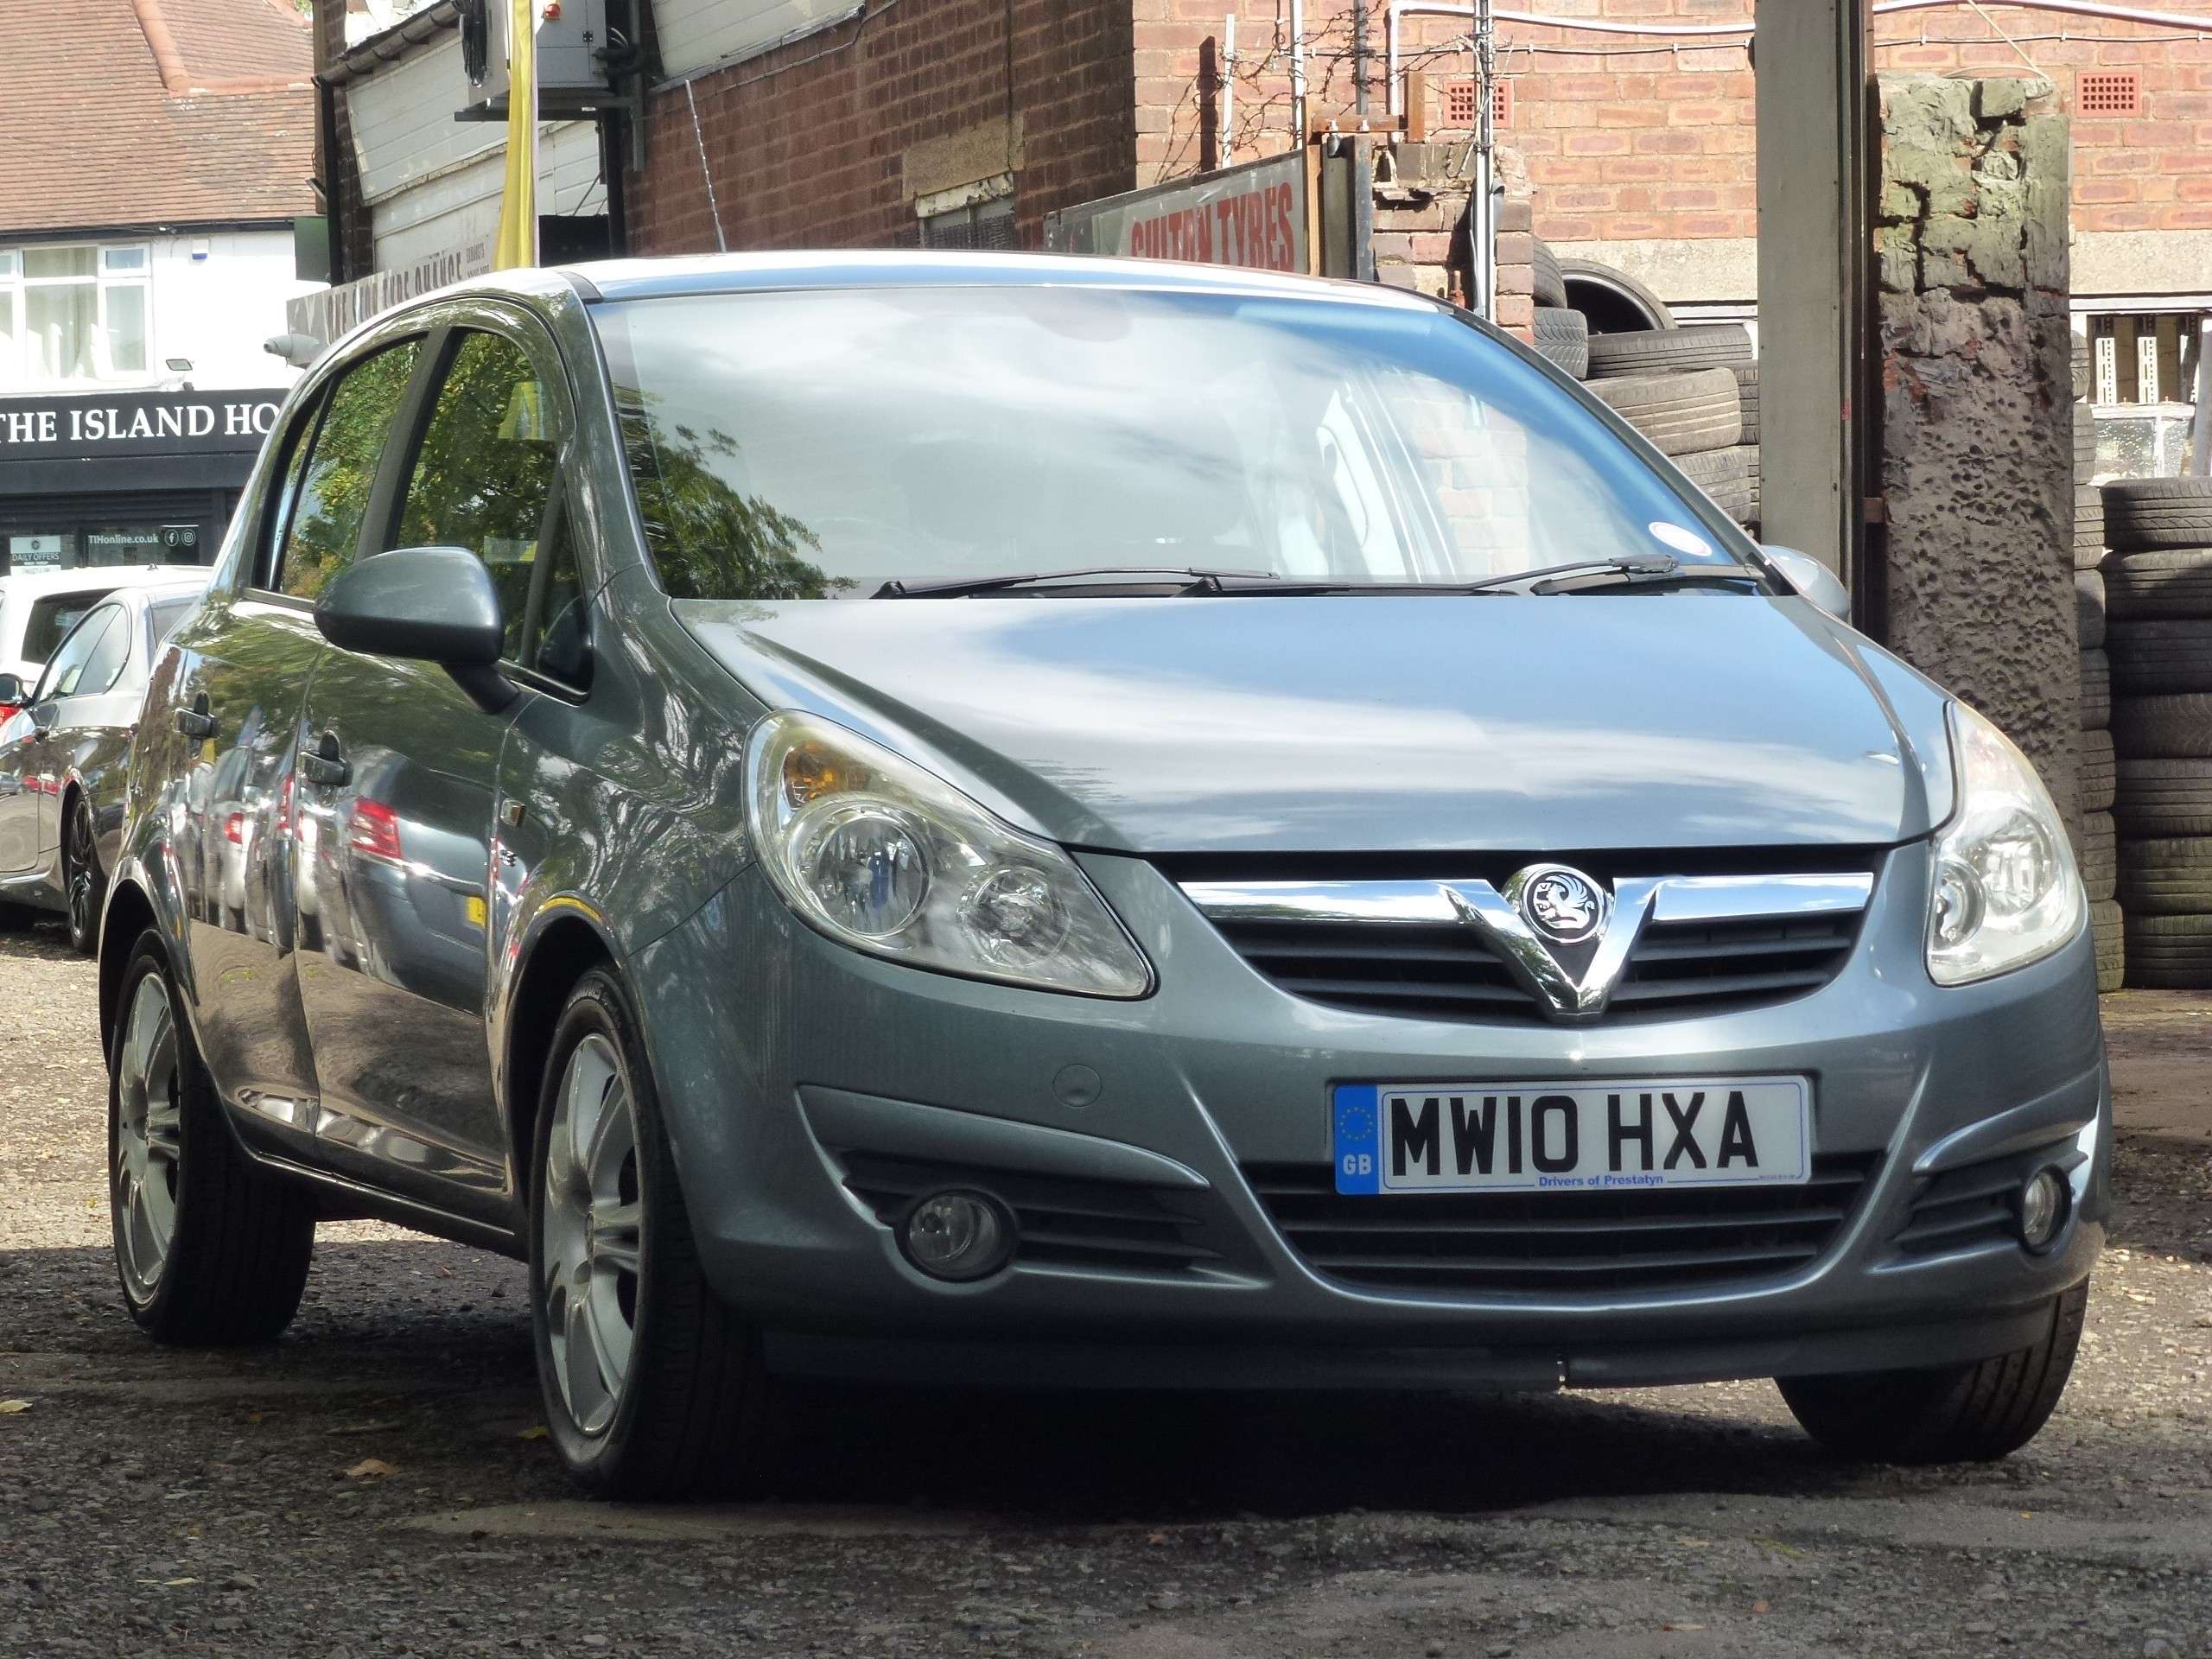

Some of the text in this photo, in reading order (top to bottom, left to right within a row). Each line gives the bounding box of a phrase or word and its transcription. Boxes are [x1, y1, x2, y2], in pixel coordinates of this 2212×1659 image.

[1217, 181, 1294, 273] TYRES
[0, 403, 280, 443] HE ISLAND HO
[12, 552, 60, 562] DAILY OFFERS
[1390, 1090, 1759, 1177] MW10 HXA
[1343, 1154, 1373, 1176] GB
[1539, 1174, 1664, 1187] Drivers of Prestatyn
